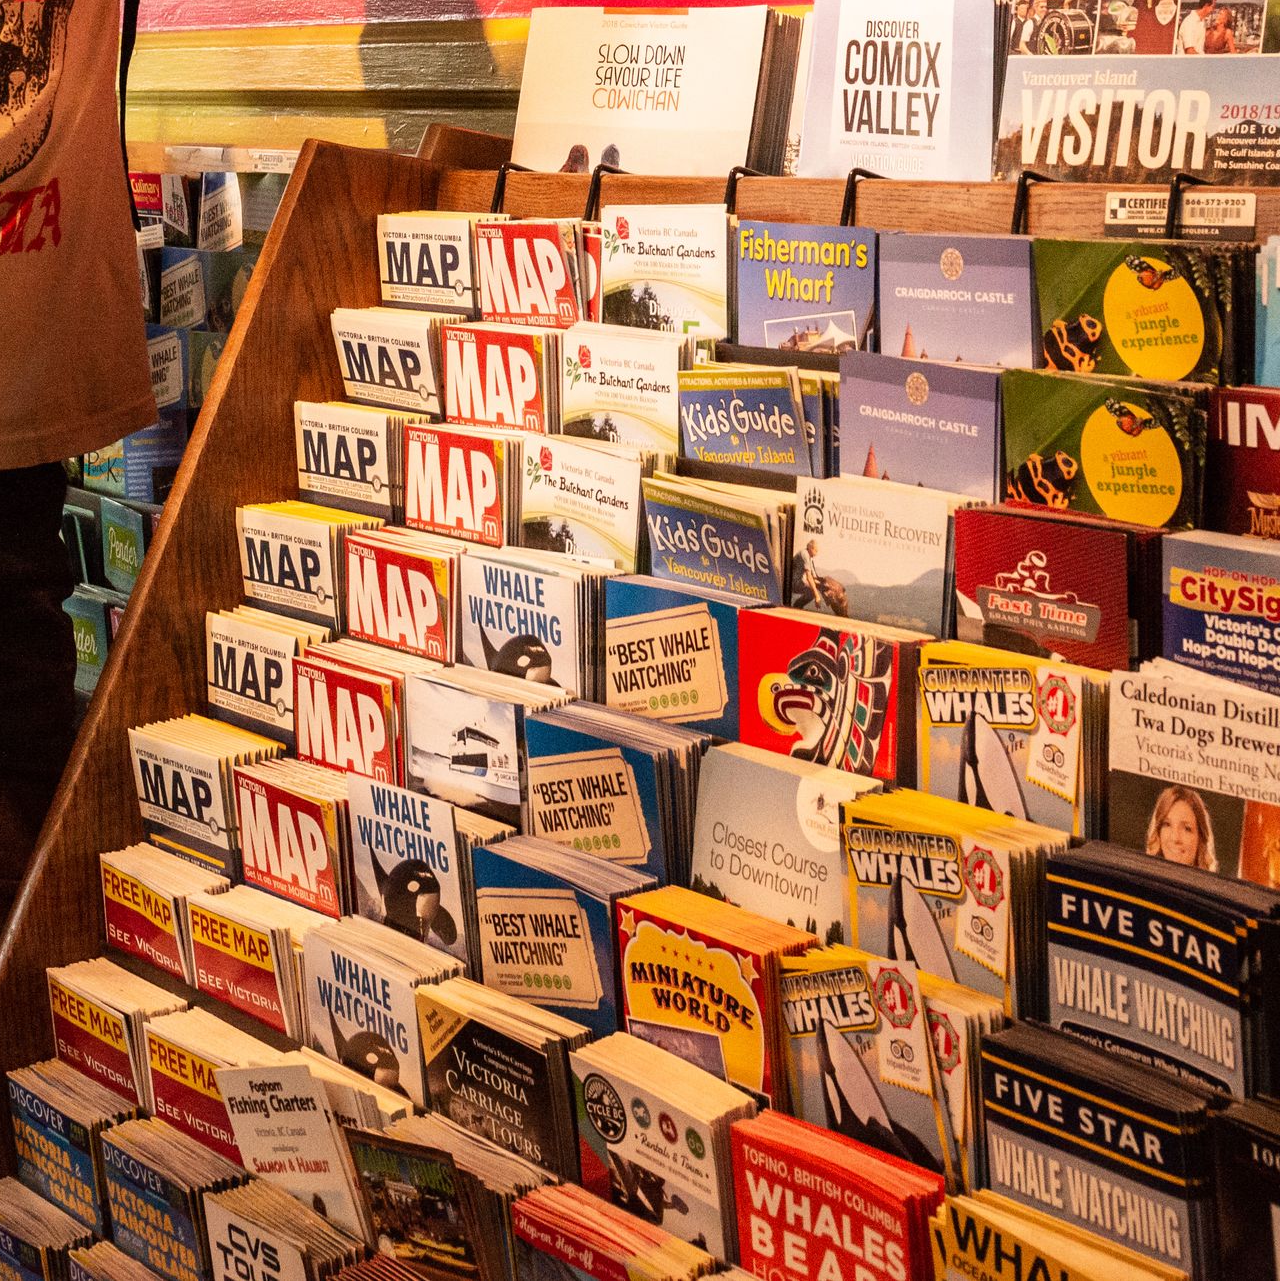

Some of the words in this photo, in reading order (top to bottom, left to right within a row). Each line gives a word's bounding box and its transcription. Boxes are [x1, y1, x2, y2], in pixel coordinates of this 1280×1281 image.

[866, 20, 920, 39] DISCOVER
[598, 44, 641, 64] SLOW
[645, 45, 686, 66] DOWN
[844, 39, 942, 89] COMOX
[595, 65, 651, 87] SAVOUR
[654, 68, 682, 89] LIFE
[1021, 69, 1089, 87] Vancouver
[1093, 70, 1138, 87] Island
[592, 87, 680, 112] COWICHAN
[842, 89, 940, 138] VALLEY
[1020, 87, 1212, 172] VISITOR
[386, 242, 460, 286] MAP
[740, 229, 868, 269] Fisherman's
[764, 267, 835, 303] Wharf
[1120, 330, 1199, 350] experience
[1133, 314, 1181, 334] jungle
[923, 668, 1037, 694] GUARANTEED
[1120, 678, 1217, 716] Caledonian
[925, 691, 1037, 725] WHALES
[1132, 707, 1169, 731] Twa
[1172, 716, 1214, 748] Dogs
[711, 821, 767, 861] Closest
[770, 842, 829, 882] Course
[709, 848, 724, 870] to
[728, 856, 820, 905] Downtown!
[191, 911, 230, 951] FREE
[232, 932, 270, 963] MAP
[1061, 894, 1134, 940] FIVE
[1148, 923, 1223, 975] STAR
[331, 950, 391, 1005] WHALE
[317, 977, 409, 1055] WATCHING
[1053, 956, 1130, 1026] WHALE
[1133, 981, 1236, 1071] WATCHING
[228, 1095, 273, 1117] Fishing
[275, 1094, 317, 1114] Charters
[444, 1068, 525, 1130] CARRIAGE
[794, 1166, 841, 1203] BRITISH
[844, 1191, 904, 1235] COLUMBIA
[745, 1169, 906, 1277] WHALES
